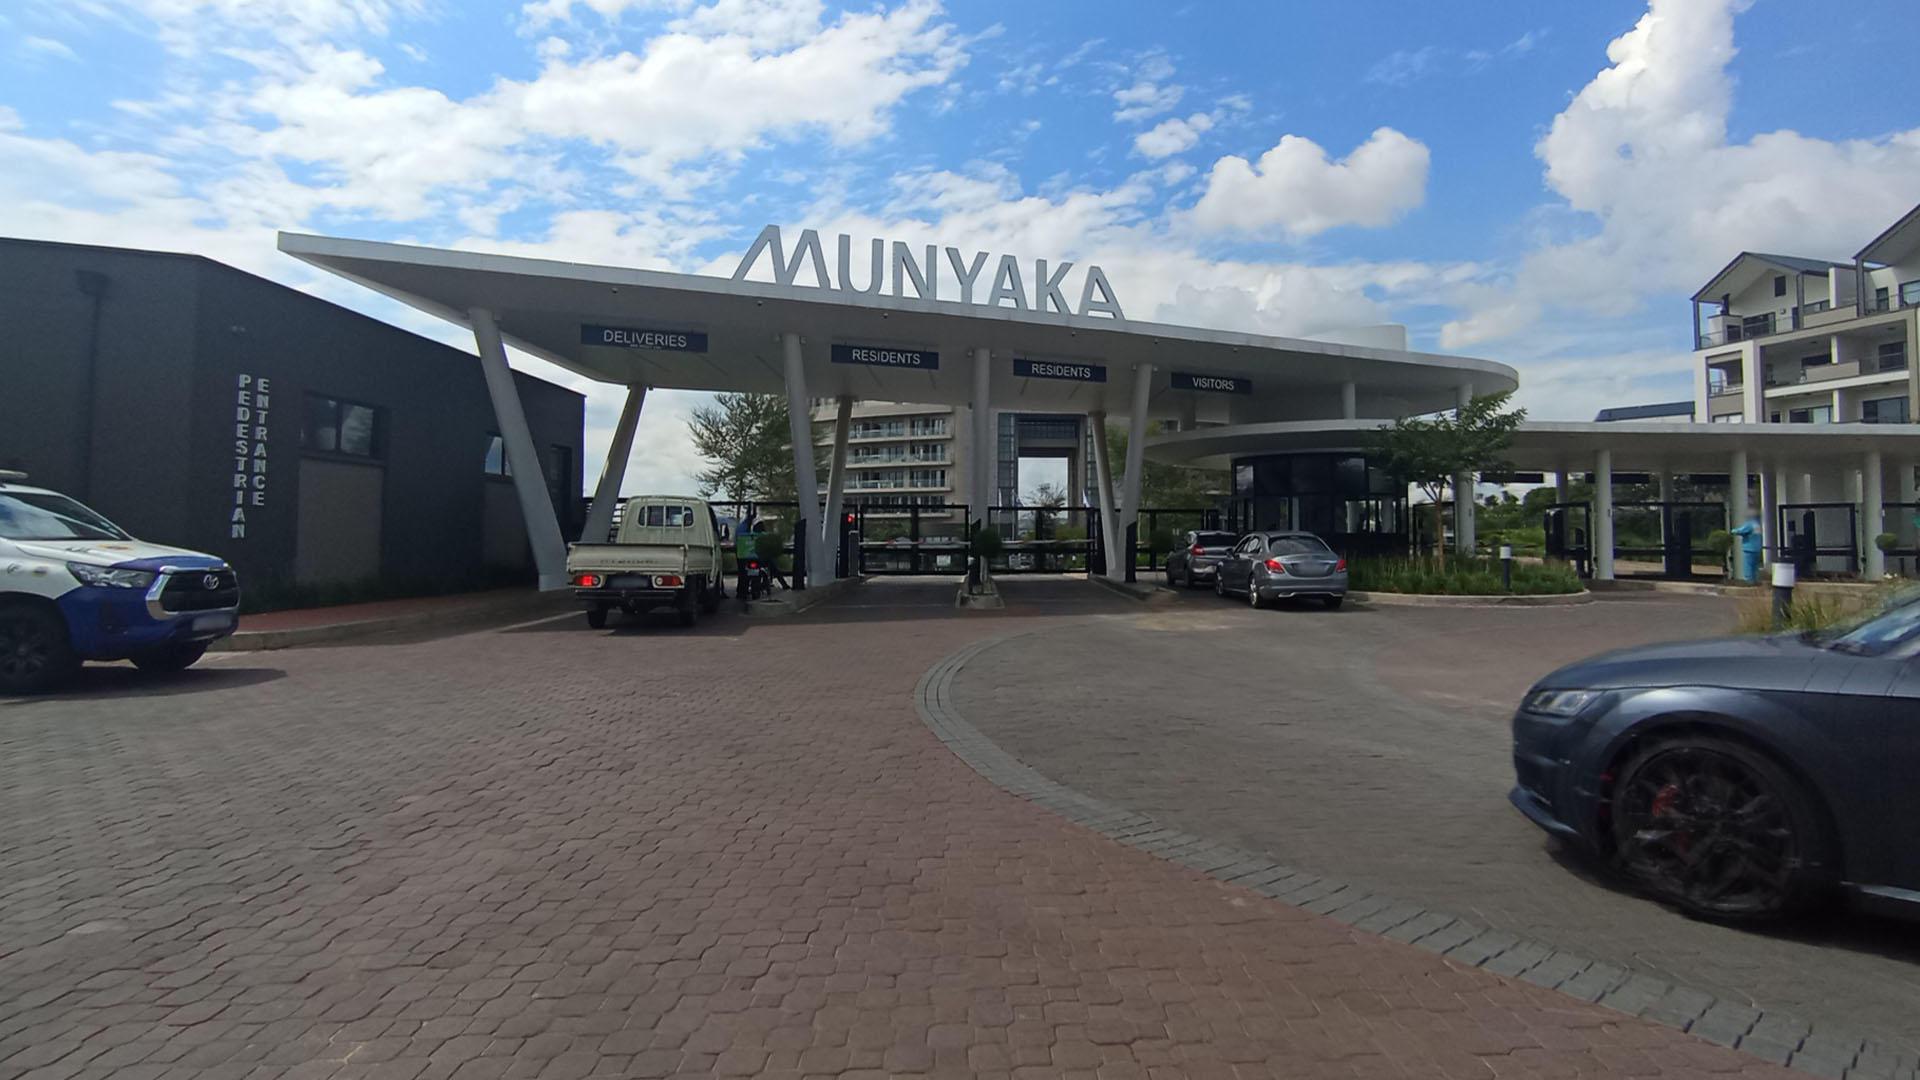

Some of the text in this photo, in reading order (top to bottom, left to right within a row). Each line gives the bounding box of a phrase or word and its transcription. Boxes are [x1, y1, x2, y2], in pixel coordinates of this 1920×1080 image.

[731, 224, 1126, 320] MUNYAKA
[603, 329, 687, 348] DELIVERIES
[852, 348, 921, 365] RESIDENTS
[1031, 363, 1091, 378] RESIDENTS
[1192, 376, 1234, 391] VISITORS
[252, 378, 270, 506] ENTRANCE
[231, 373, 252, 539] PEDESTRIAN
